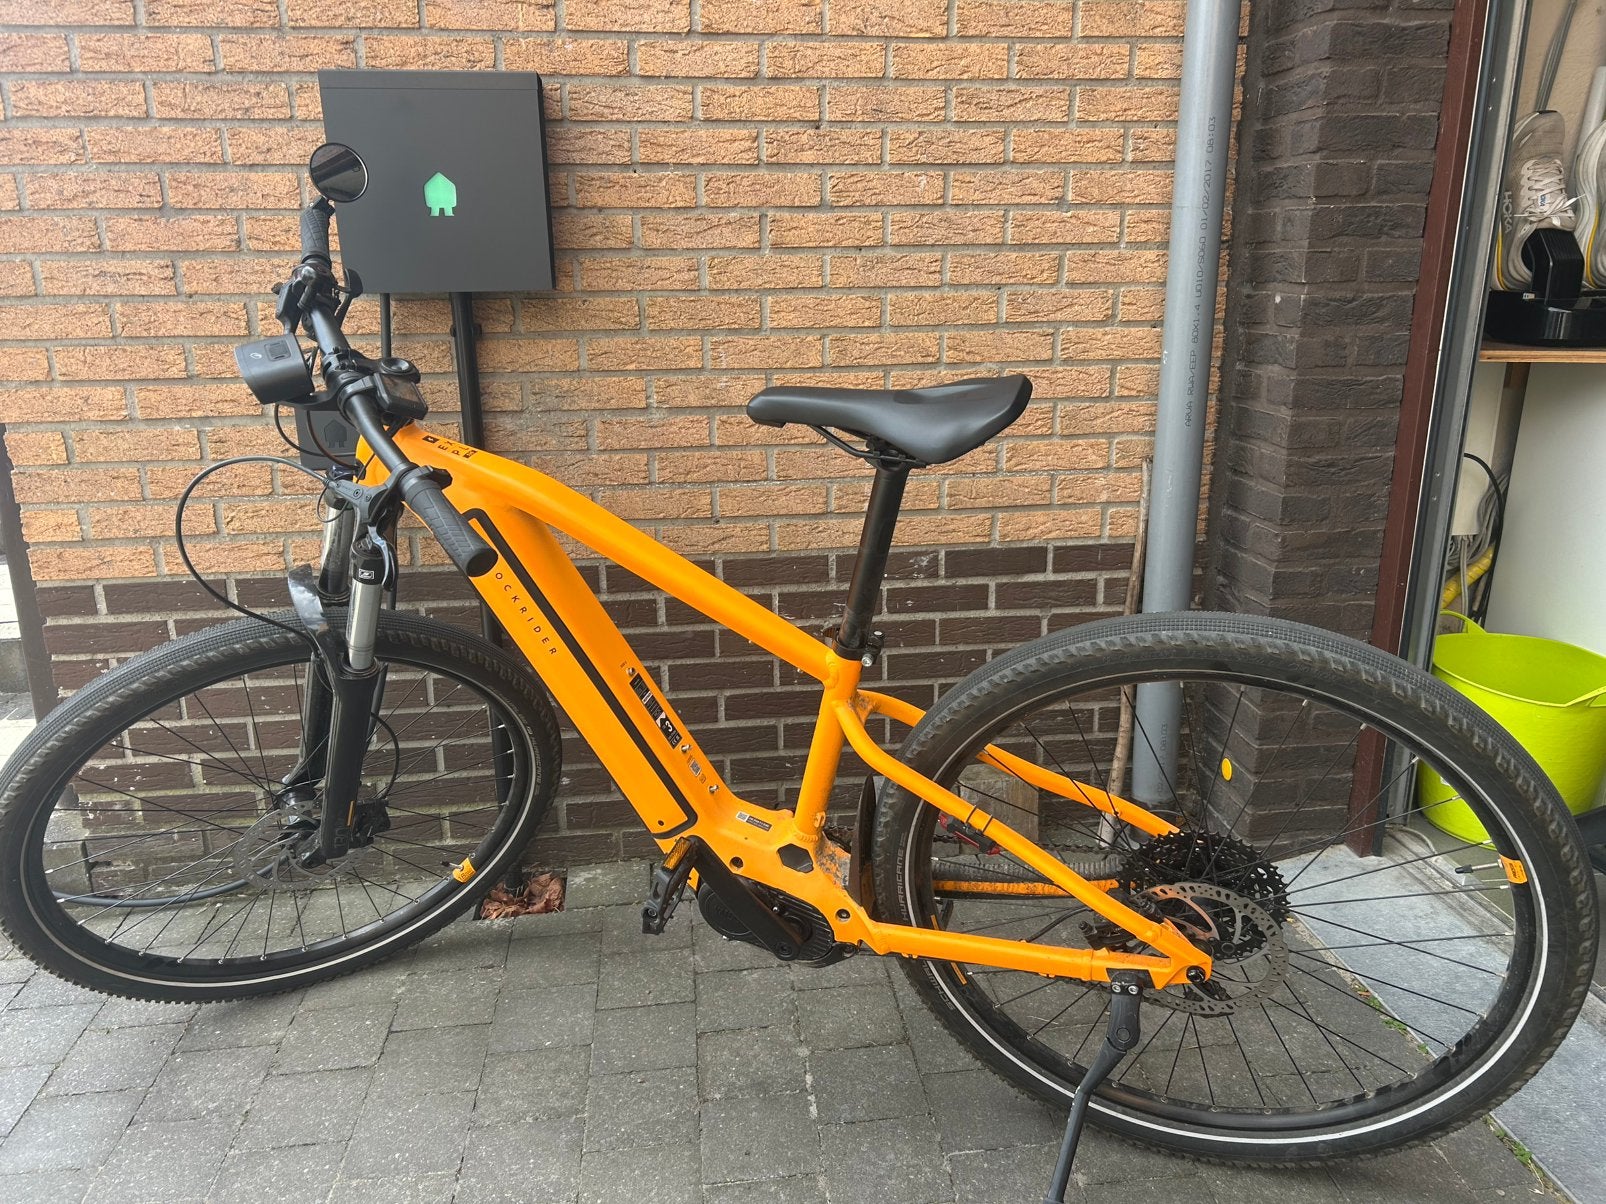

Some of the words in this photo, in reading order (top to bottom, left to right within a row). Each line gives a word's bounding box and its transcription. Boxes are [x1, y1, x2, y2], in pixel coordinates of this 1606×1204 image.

[1200, 160, 1212, 230] 01/02/2017
[1206, 116, 1216, 154] 08:03
[1503, 191, 1513, 234] HOKA
[495, 572, 557, 655] OCKRIDER
[665, 720, 673, 732] 3
[896, 848, 909, 921] HURRICANE
